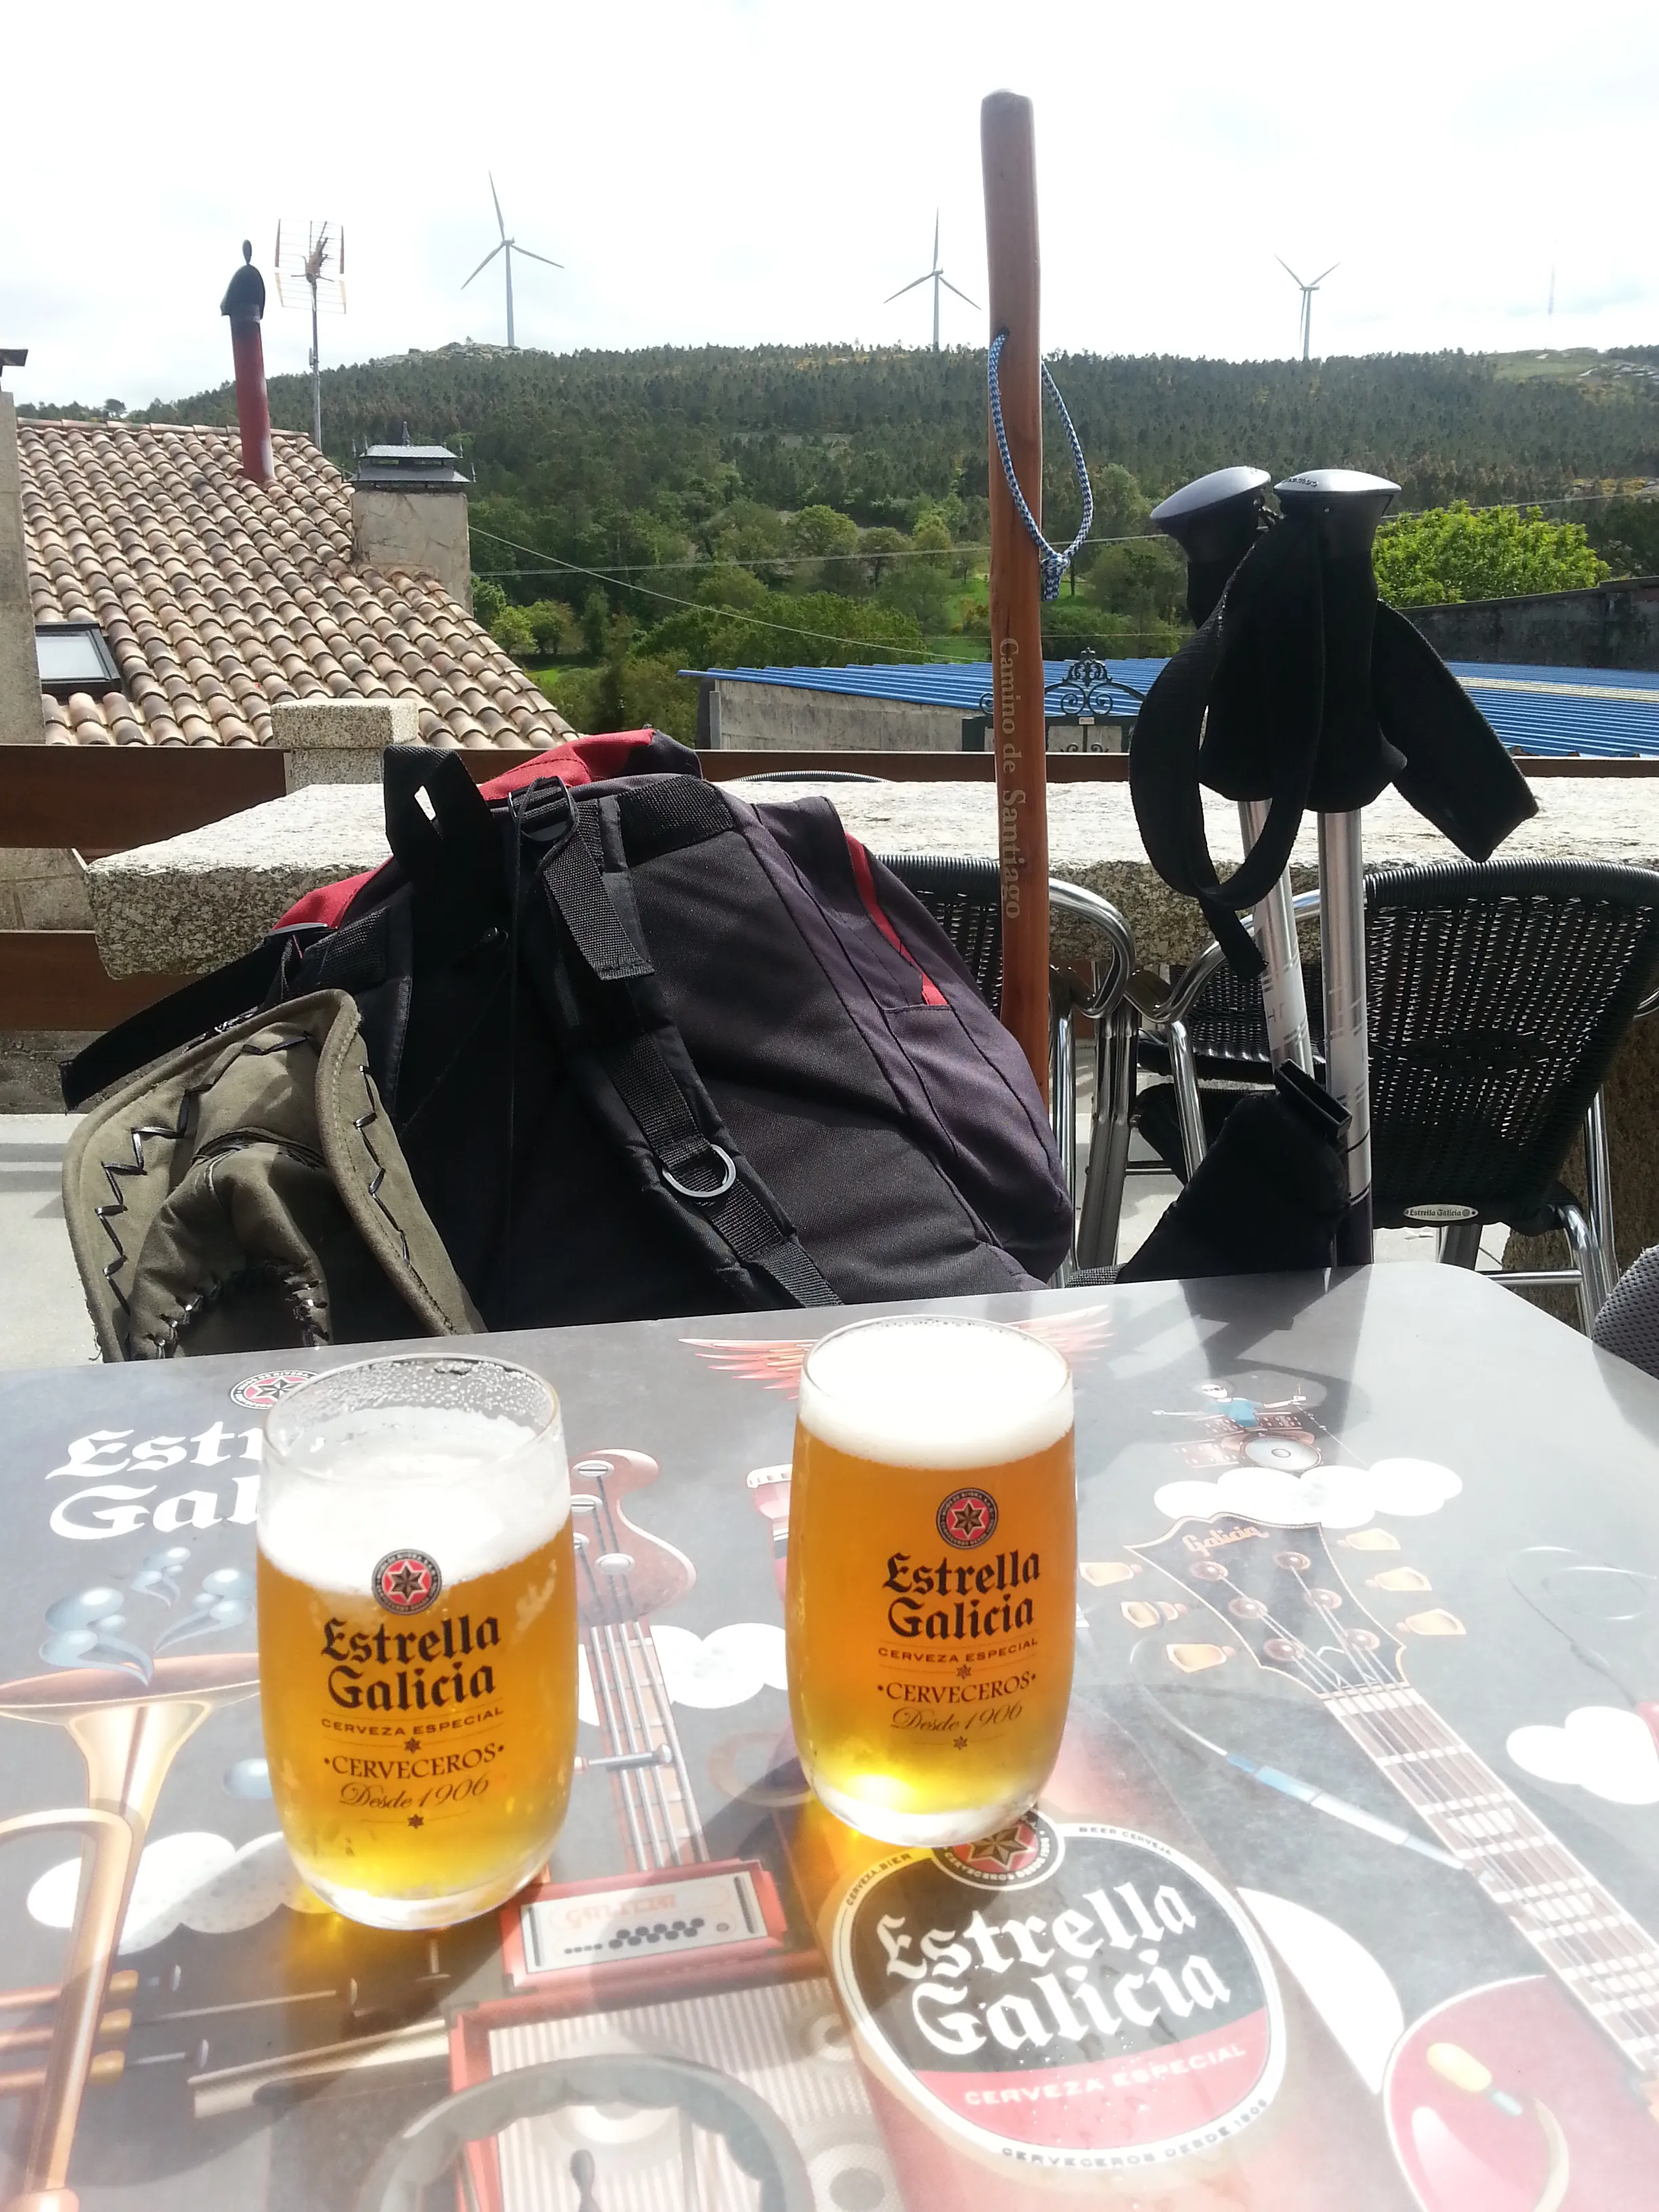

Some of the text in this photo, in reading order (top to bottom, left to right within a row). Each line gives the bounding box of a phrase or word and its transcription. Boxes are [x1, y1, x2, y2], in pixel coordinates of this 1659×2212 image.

[1000, 638, 1026, 919] Camino de Santiago
[1410, 1208, 1436, 1216] Estrella
[45, 1421, 263, 1479] Estr
[49, 1475, 260, 1540] Gal
[1182, 1526, 1269, 1557] Galicia
[882, 1549, 1040, 1596] Estrella
[321, 1614, 501, 1664] Estrella
[888, 1593, 1033, 1640] Galicia
[878, 1638, 1038, 1663] CERVEZA ESPECIAL
[328, 1661, 496, 1711] Galicia
[321, 1706, 504, 1736] CERVEZA ESPECIAL
[890, 1698, 1023, 1731] Desde 1906
[339, 1769, 491, 1809] Desde 1906
[1079, 1826, 1172, 1856] BEER CERVEJA
[876, 1882, 1196, 1980] Estrella
[912, 1948, 1231, 2055] Galicia
[965, 2043, 1247, 2106] CERVEZA ESPECIAL
[1002, 2146, 1155, 2167] CERVECEROS
[1164, 2125, 1231, 2158] DESDE
